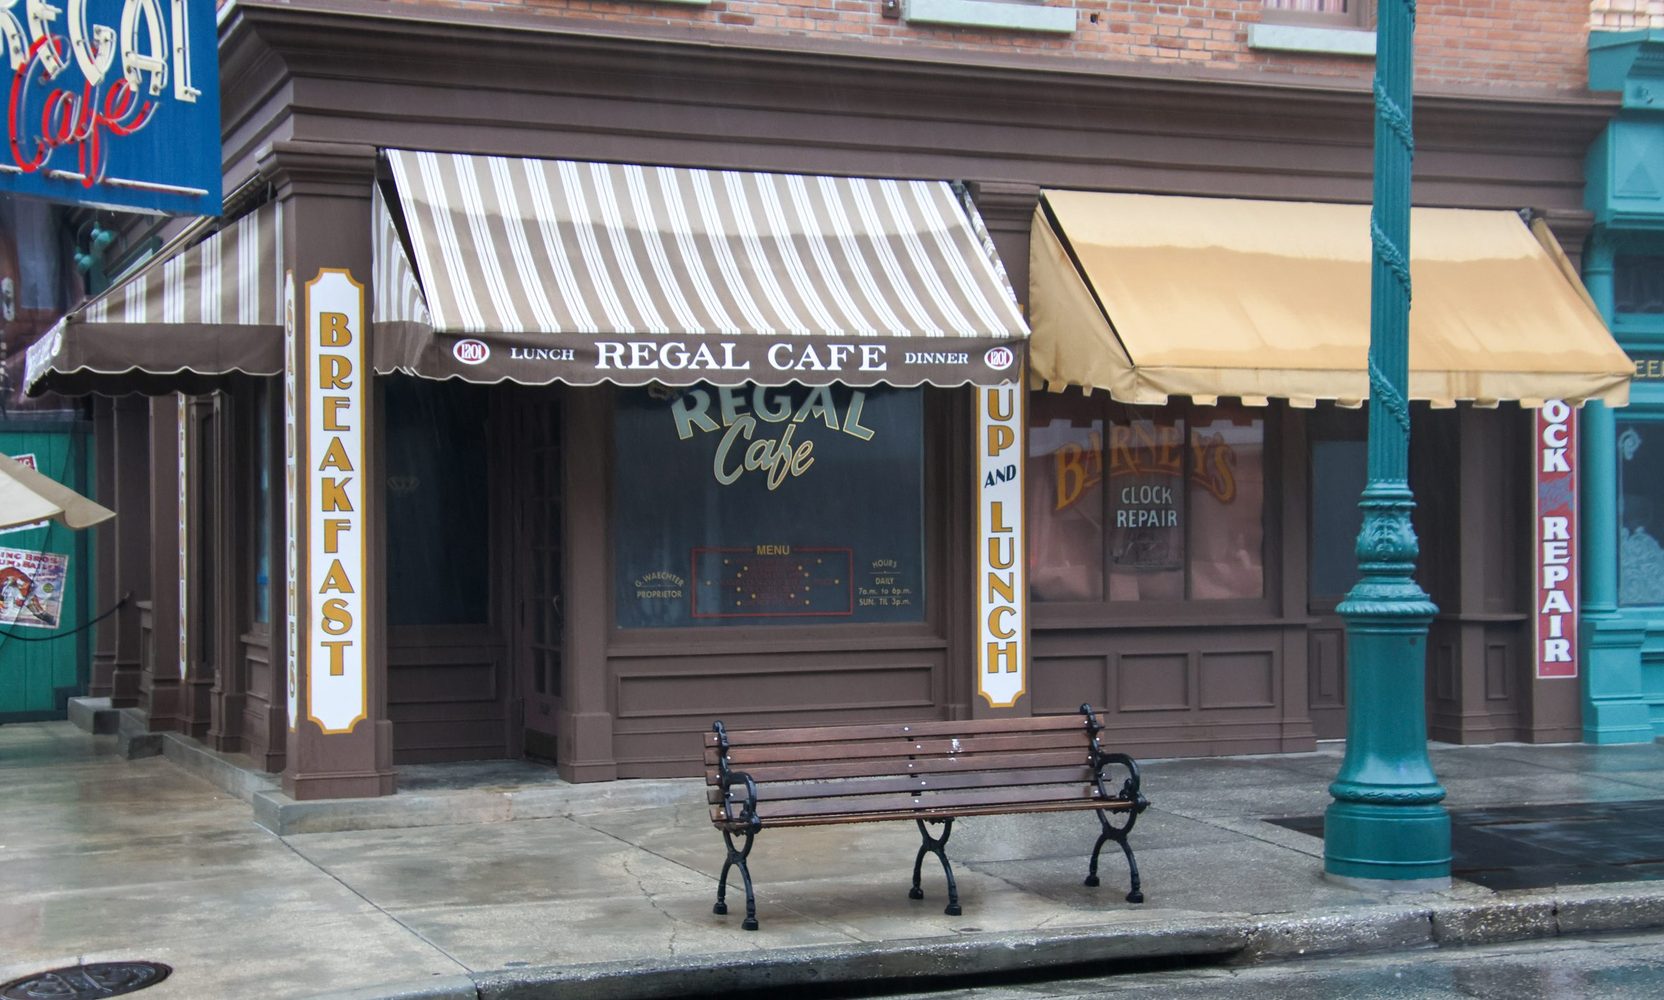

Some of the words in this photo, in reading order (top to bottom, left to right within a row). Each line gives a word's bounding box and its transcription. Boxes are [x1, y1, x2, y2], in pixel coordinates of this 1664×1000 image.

[9, 33, 160, 188] Cafe
[510, 347, 575, 361] LUNCH
[594, 341, 750, 371] REGAL
[767, 343, 888, 371] CAFE
[904, 352, 969, 365] DINNER
[671, 384, 876, 441] REGAL
[713, 414, 815, 491] Cafe
[984, 464, 1017, 488] AND
[318, 311, 355, 677] BREAKFAST
[1121, 486, 1173, 505] CLOCK
[1117, 510, 1178, 528] REPAIR
[756, 545, 790, 556] MENU
[636, 590, 682, 599] PROPRIETOR
[987, 501, 1018, 674] LUNCH
[1541, 516, 1573, 663] REPAIR
